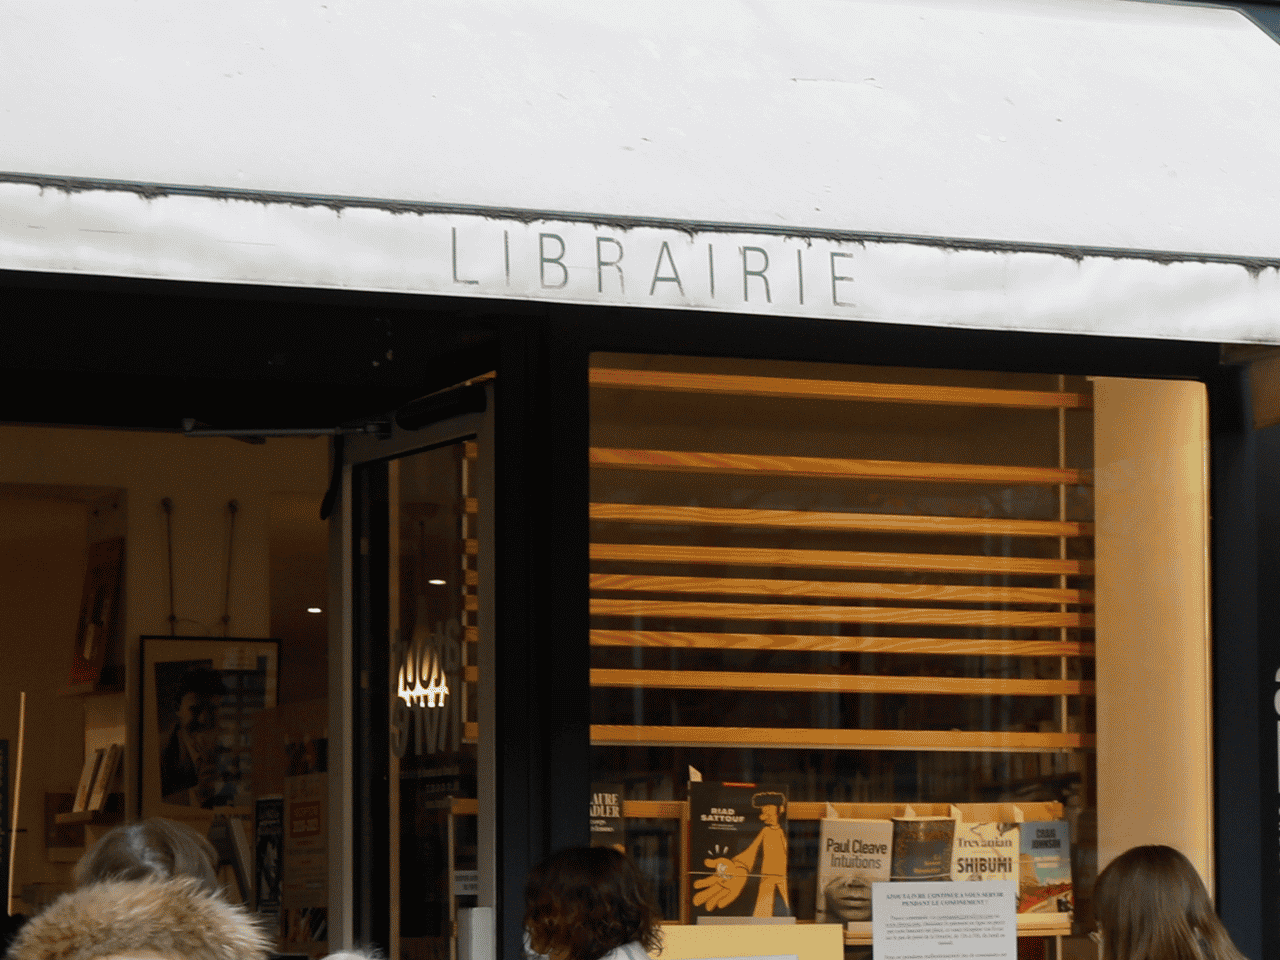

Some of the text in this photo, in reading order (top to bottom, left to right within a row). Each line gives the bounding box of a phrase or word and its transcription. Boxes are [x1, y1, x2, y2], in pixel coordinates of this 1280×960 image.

[451, 226, 856, 308] LIBRAIRIE
[700, 814, 746, 823] SATTOUF
[710, 808, 735, 816] RIAD
[826, 838, 888, 855] Paul Cleave
[830, 853, 882, 869] Intuitions
[957, 857, 1013, 873] SHIBUMI
